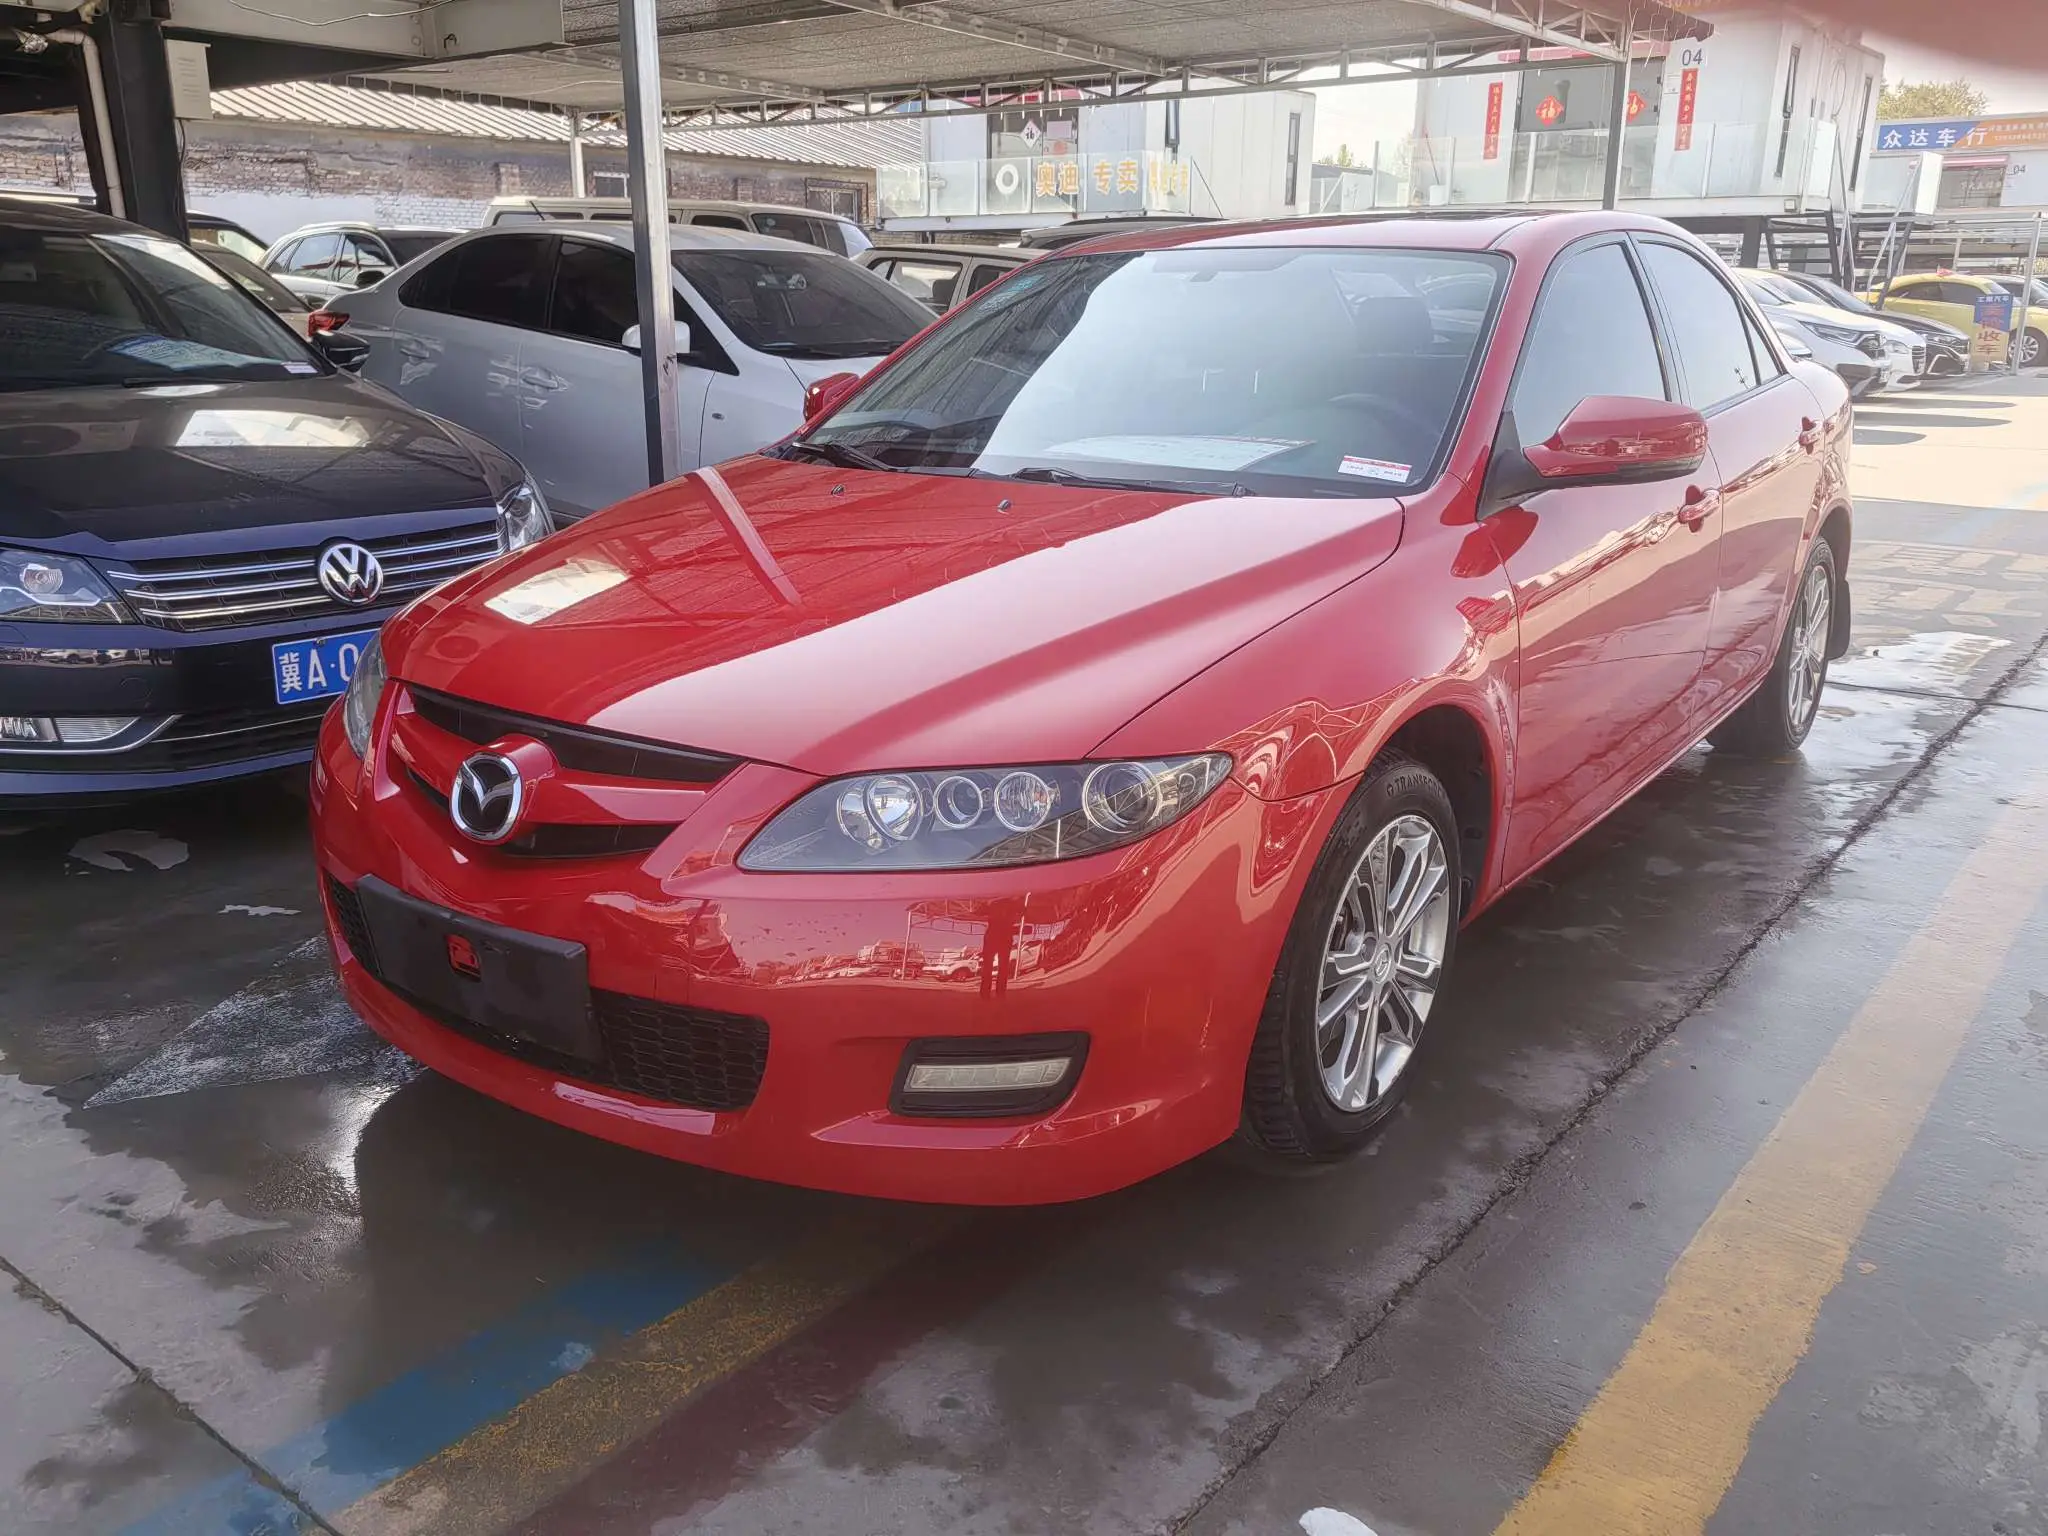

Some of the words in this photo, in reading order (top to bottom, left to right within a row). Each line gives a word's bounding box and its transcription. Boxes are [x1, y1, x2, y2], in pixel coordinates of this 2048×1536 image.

[1682, 49, 1703, 66] 04
[1883, 127, 1988, 149] 众达车行
[1036, 160, 1138, 197] 奥迪专卖
